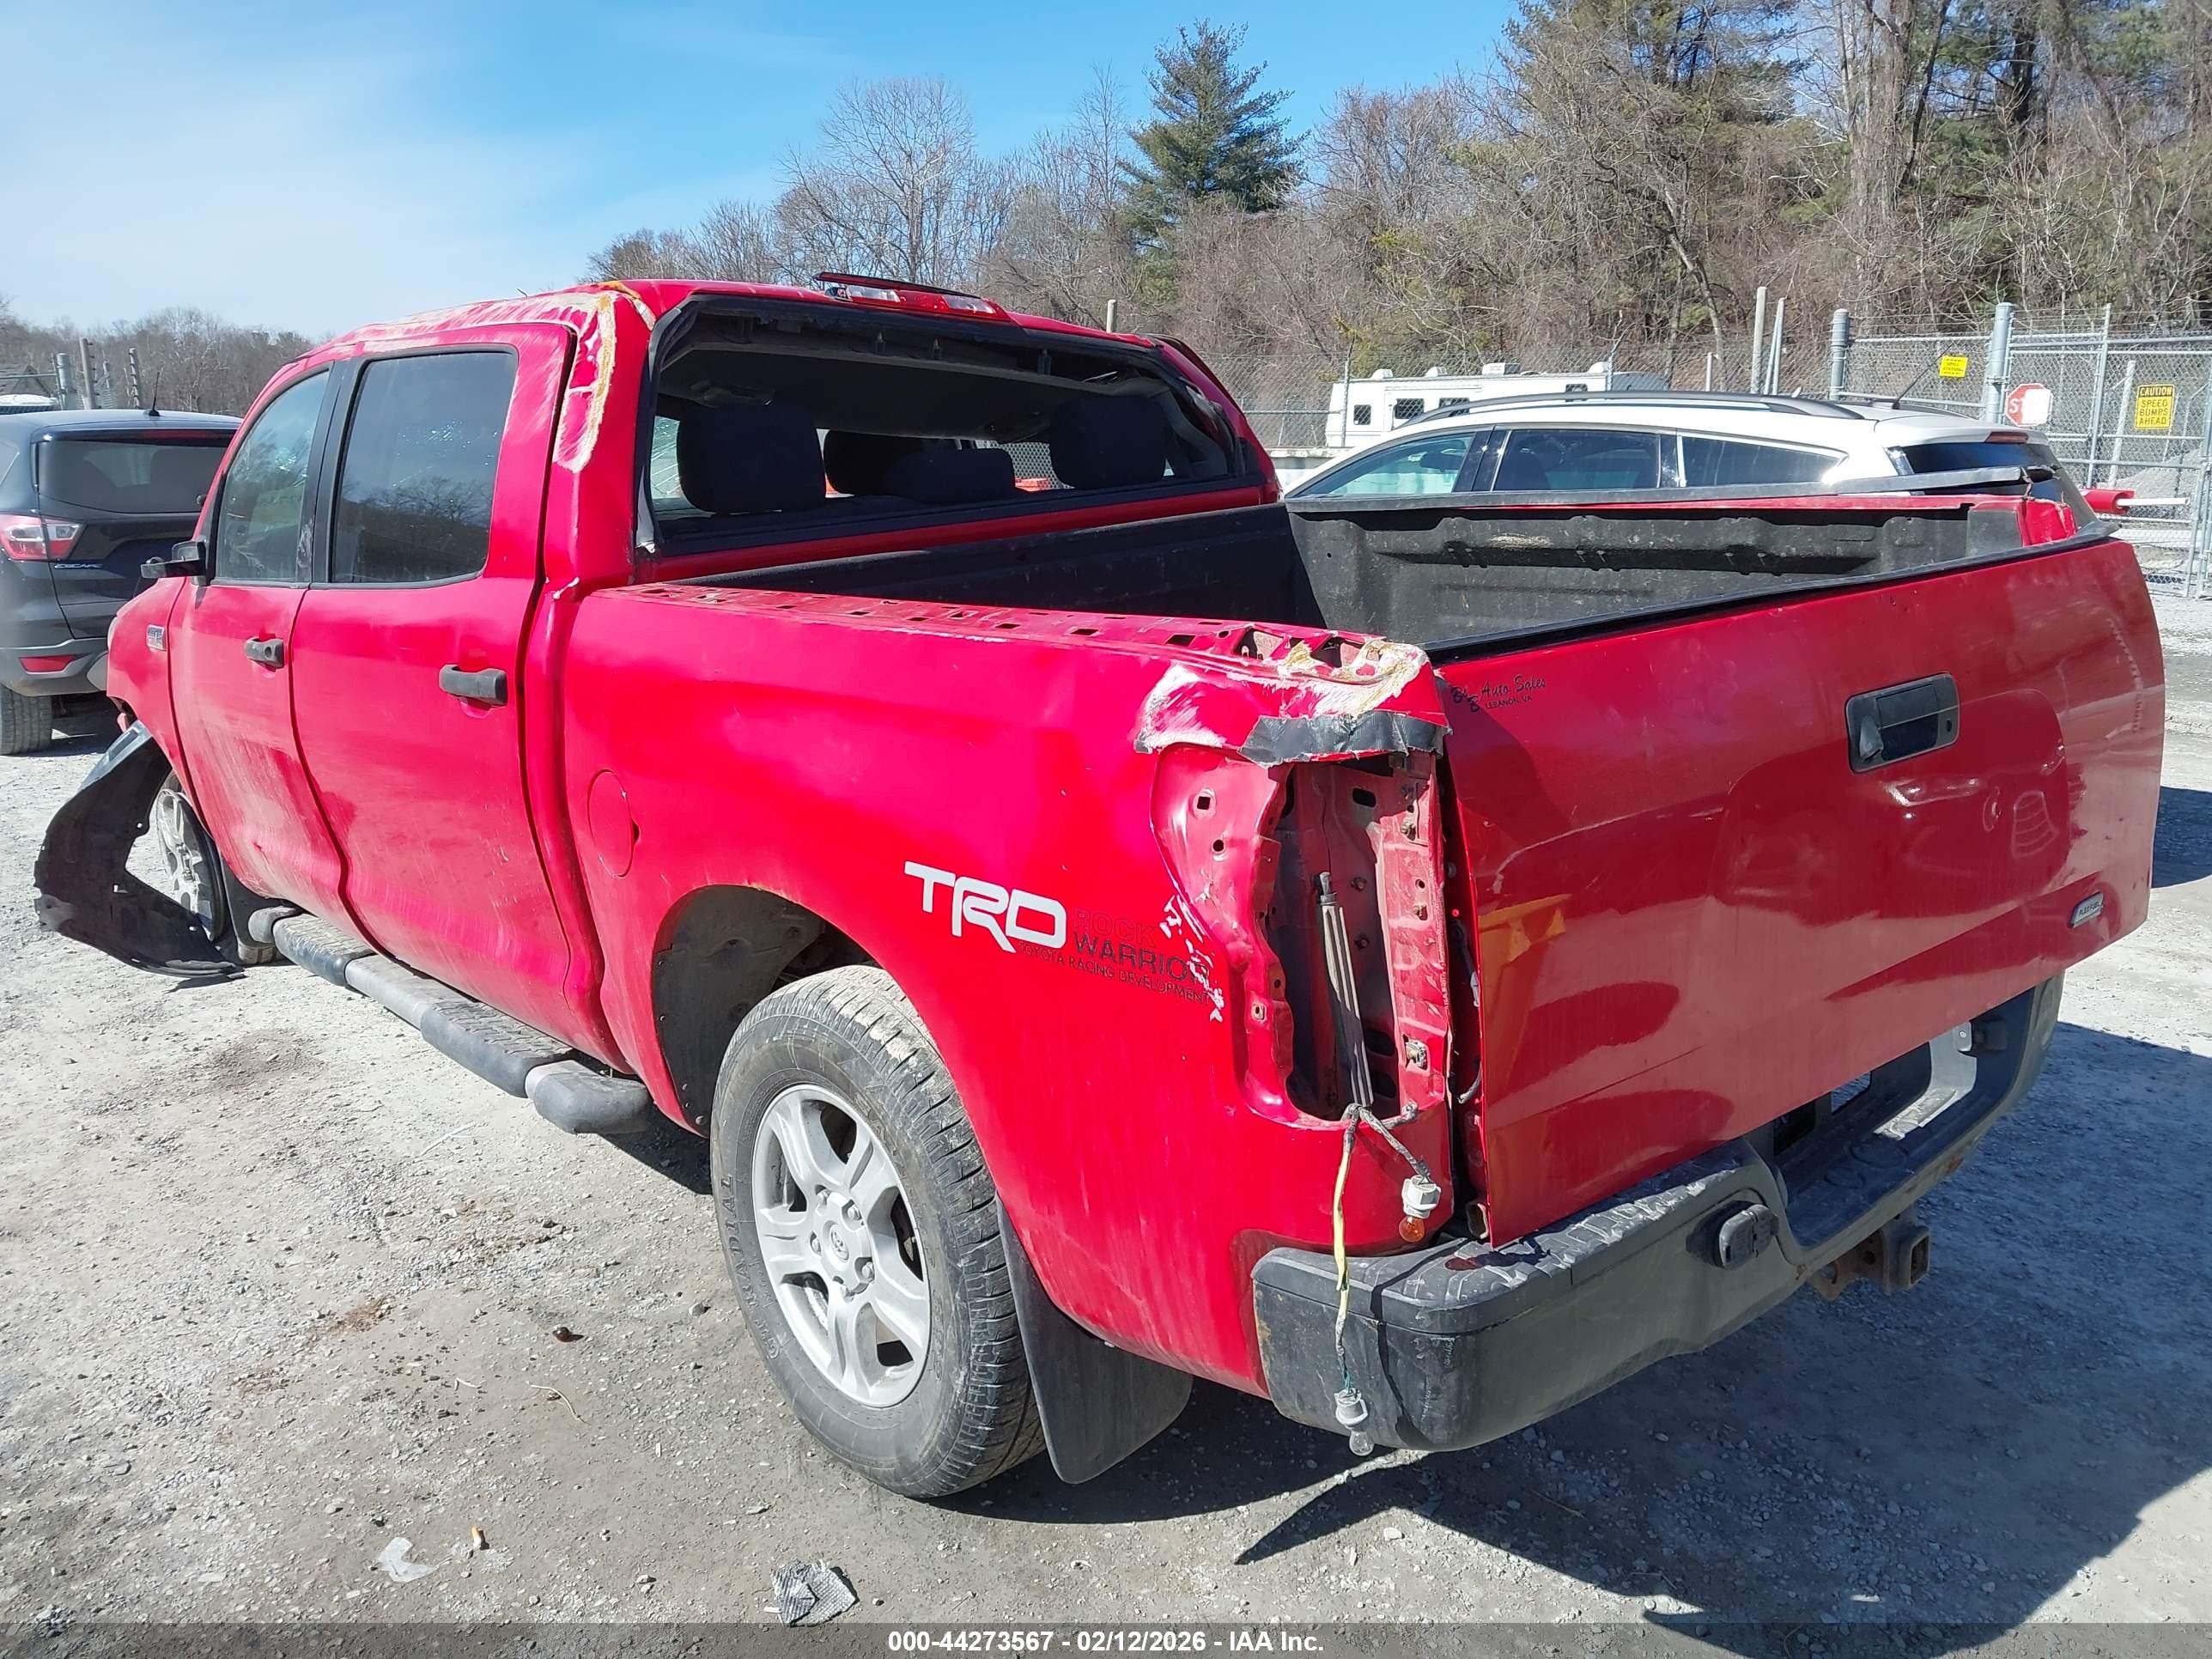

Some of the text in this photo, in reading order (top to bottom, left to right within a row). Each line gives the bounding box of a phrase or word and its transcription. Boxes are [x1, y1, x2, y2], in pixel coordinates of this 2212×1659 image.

[2140, 386, 2172, 396] CAUTION
[2141, 399, 2168, 408] SPEED
[2139, 408, 2168, 416] BUMPS
[2139, 416, 2167, 425] AHEAD
[1481, 680, 1509, 697] Auto
[1514, 674, 1547, 692] Sales
[904, 860, 1066, 953] TRD
[1018, 940, 1211, 1005] TOYOTA RACING DEVELOPMENT
